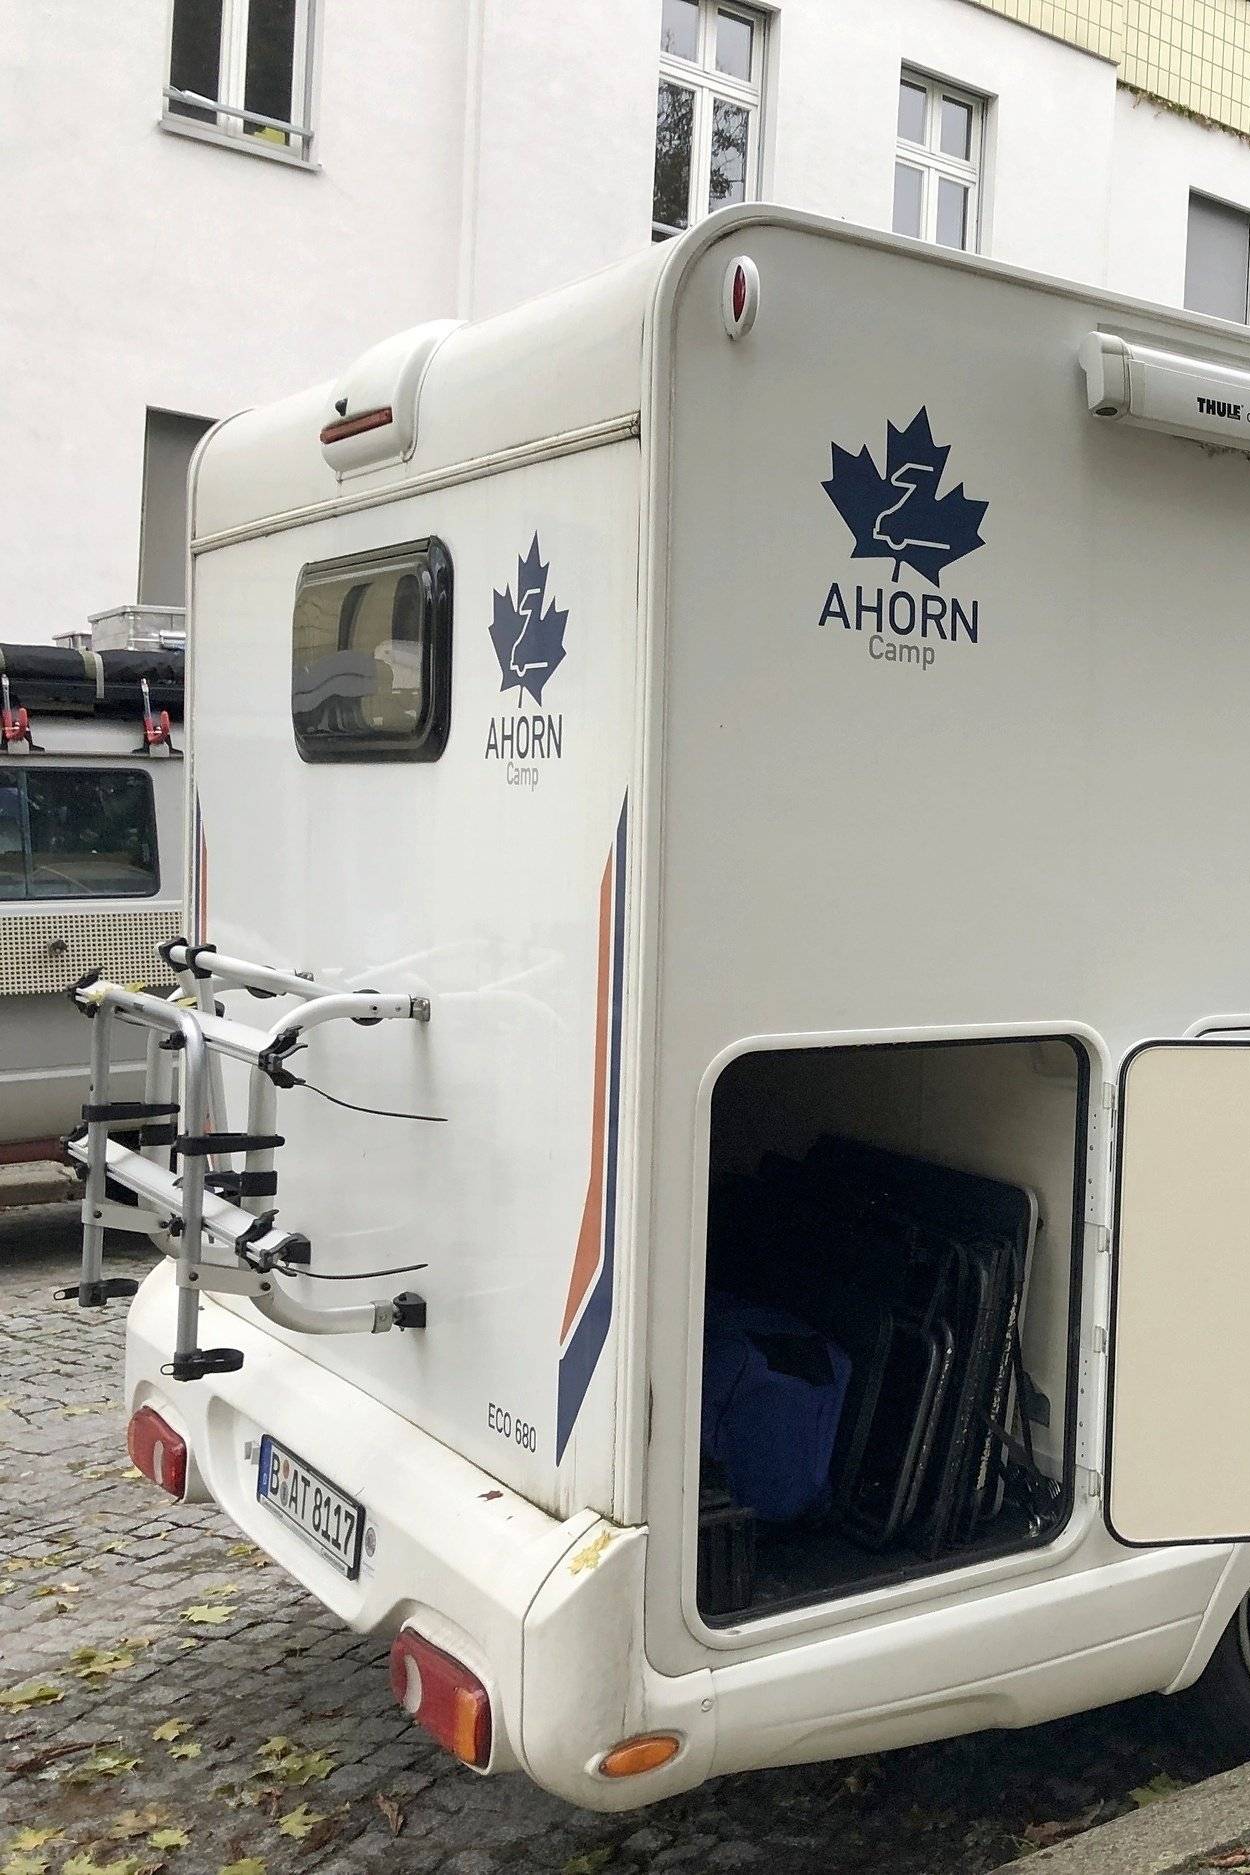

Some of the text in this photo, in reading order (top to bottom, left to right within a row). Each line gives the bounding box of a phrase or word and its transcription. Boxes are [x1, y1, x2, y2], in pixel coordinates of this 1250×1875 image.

[1196, 397, 1241, 421] THULE
[818, 582, 979, 644] AHORN
[868, 634, 935, 671] Camp
[484, 713, 563, 760] AHORN
[506, 761, 539, 792] Camp
[488, 1402, 537, 1453] ECO 680
[269, 1451, 281, 1497] B
[288, 1469, 311, 1520] AT
[312, 1487, 355, 1556] 8117
